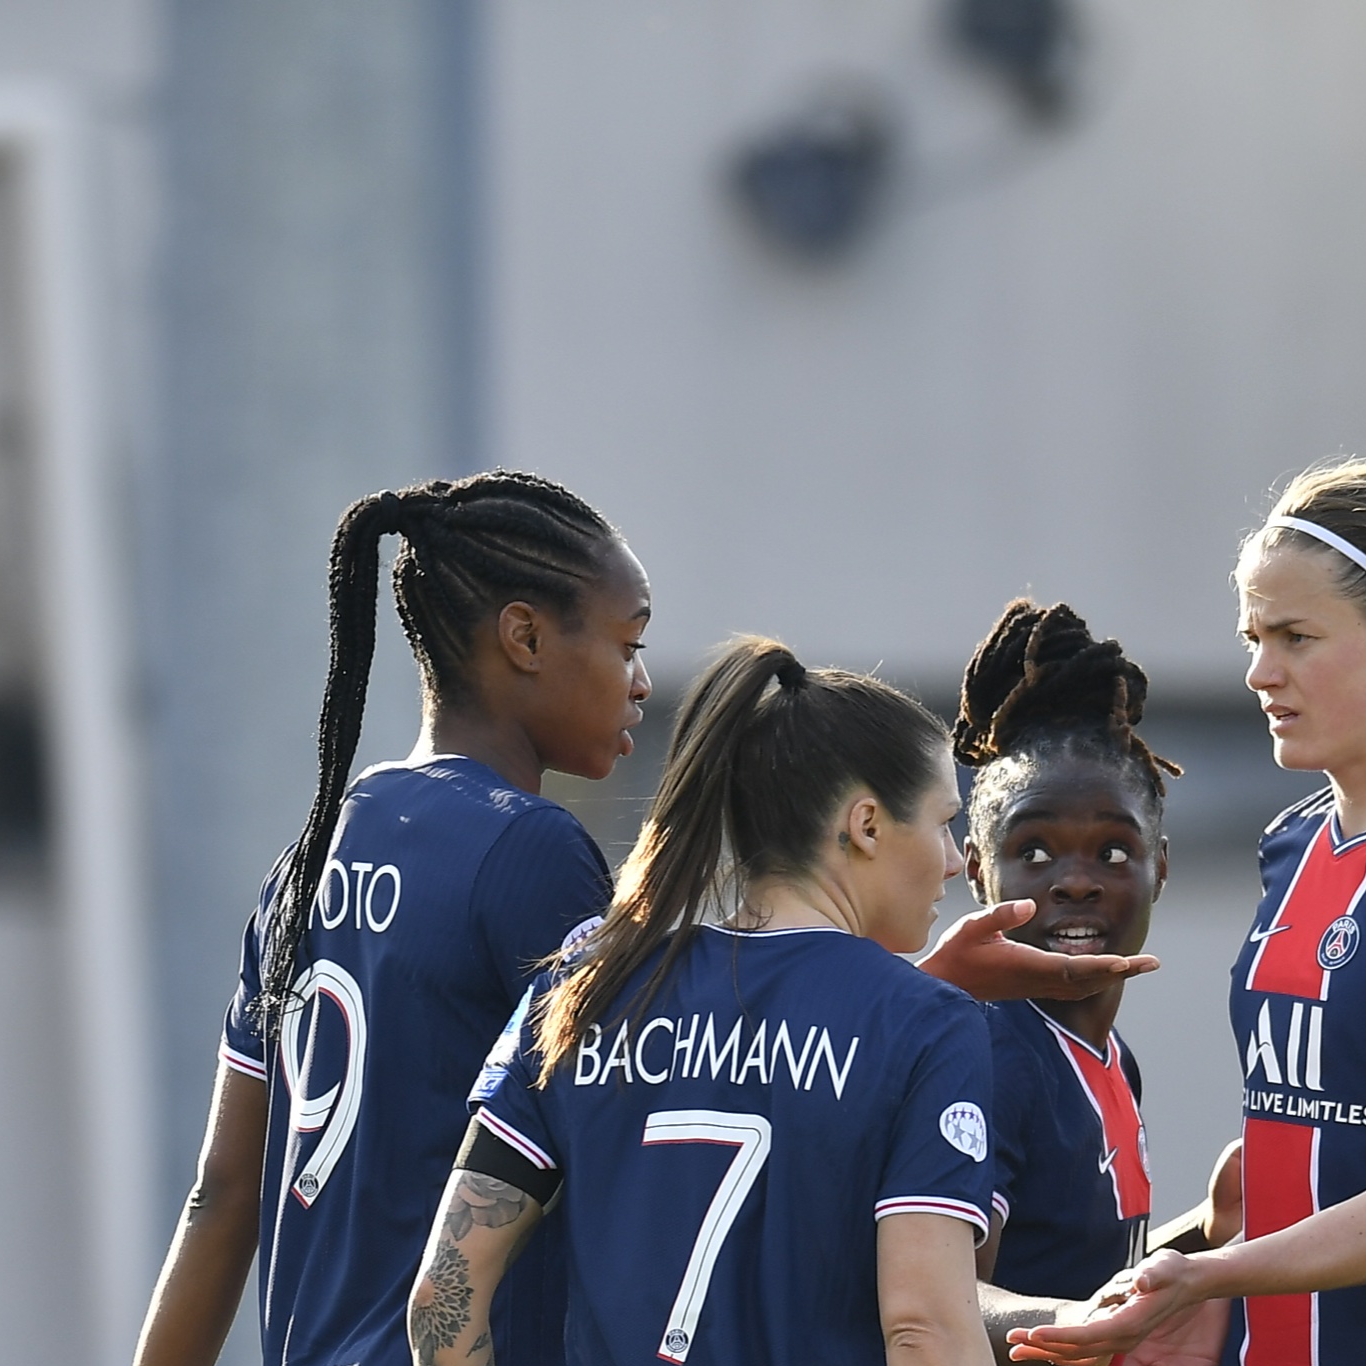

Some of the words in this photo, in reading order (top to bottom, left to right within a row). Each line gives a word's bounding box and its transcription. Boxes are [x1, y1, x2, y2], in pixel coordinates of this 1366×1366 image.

[280, 958, 367, 1209] 9
[574, 1011, 859, 1101] BACHMANN
[1250, 1090, 1283, 1113] LIVE
[641, 1109, 773, 1366] 7
